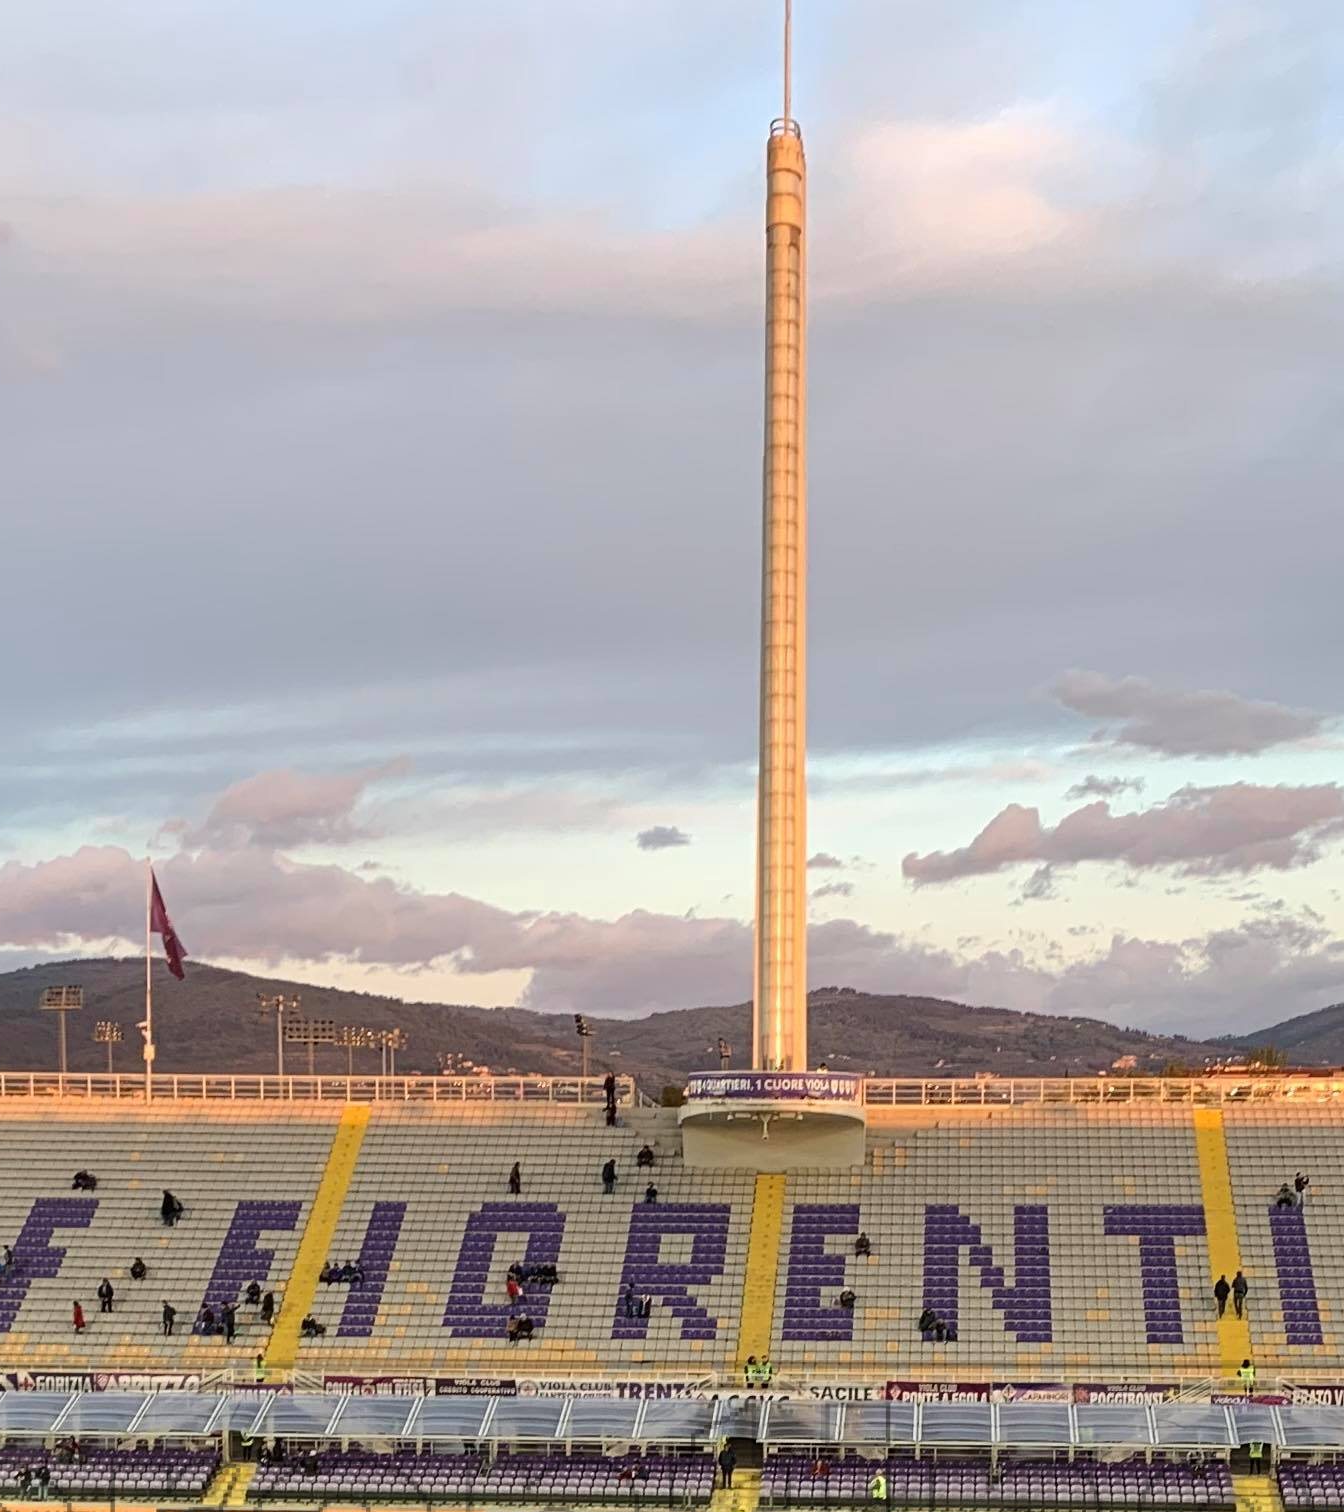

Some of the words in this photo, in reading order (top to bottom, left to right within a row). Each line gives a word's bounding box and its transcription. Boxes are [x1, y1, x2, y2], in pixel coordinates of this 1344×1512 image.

[764, 1079, 803, 1091] CUORE
[805, 1079, 830, 1091] VIOLA
[35, 1374, 95, 1392] GORIZIA
[539, 1382, 576, 1391] VIOLA
[580, 1382, 612, 1391] CLUB
[616, 1382, 696, 1400] TRENT
[809, 1386, 872, 1401] SACILE
